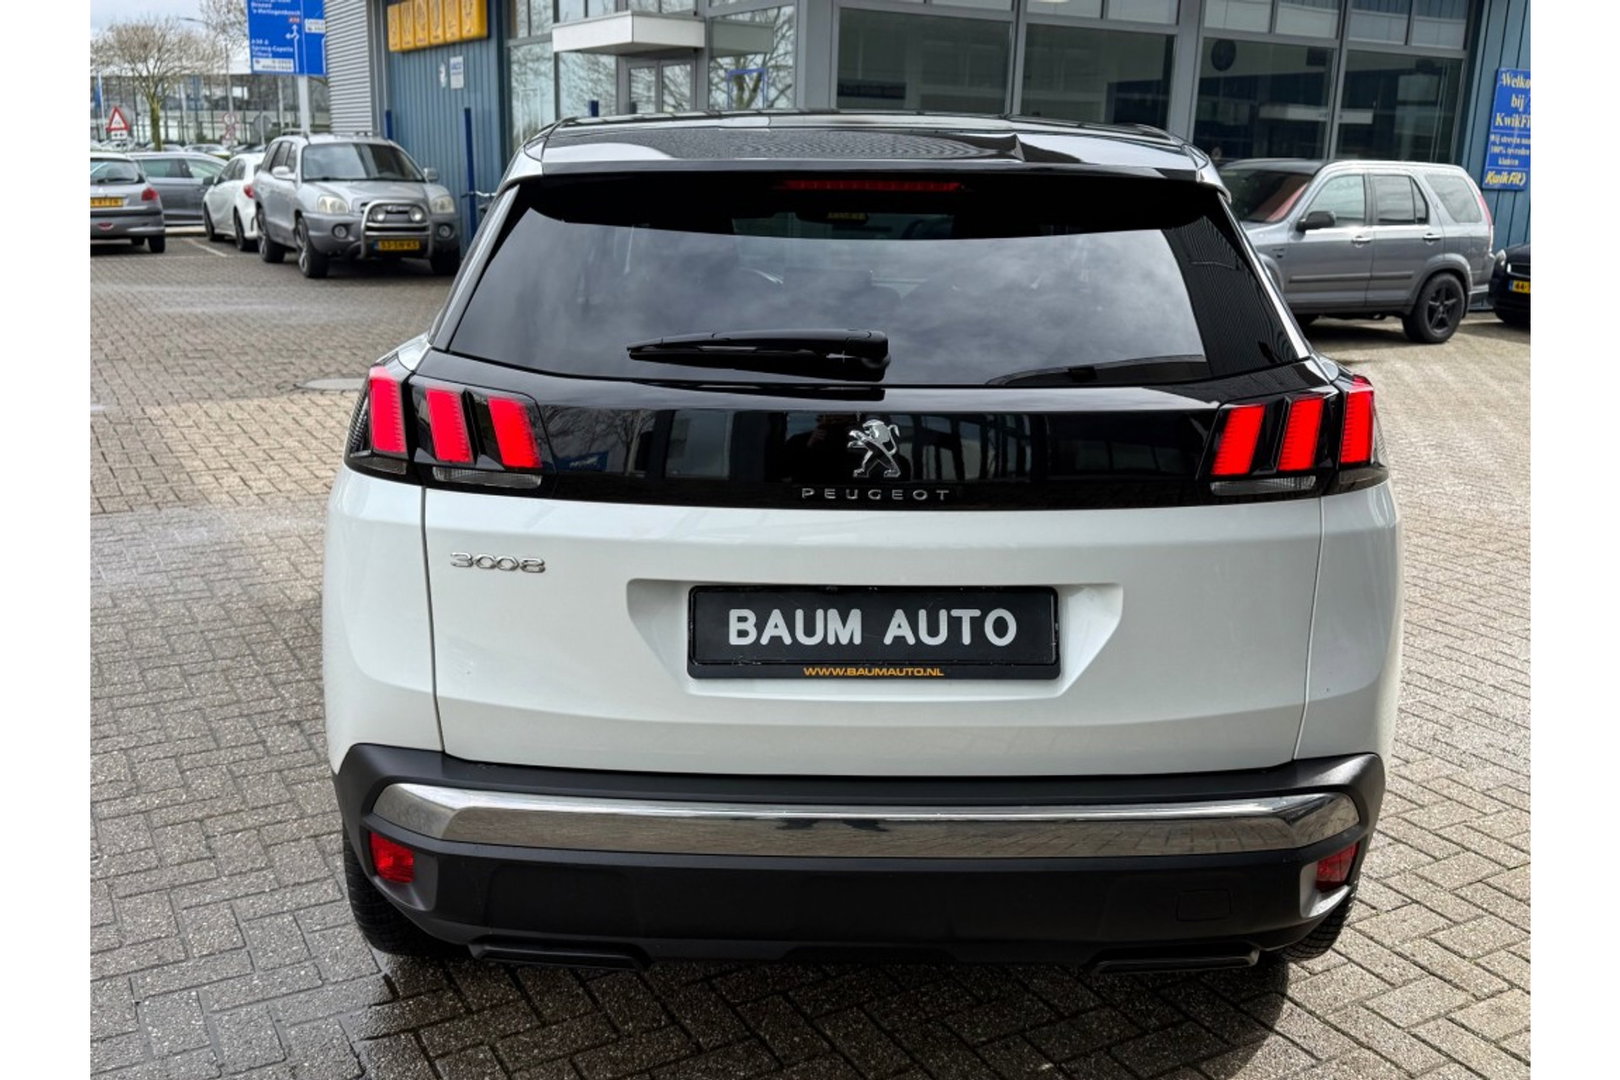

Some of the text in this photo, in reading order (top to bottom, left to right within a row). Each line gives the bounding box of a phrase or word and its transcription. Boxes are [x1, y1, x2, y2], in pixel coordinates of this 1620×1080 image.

[1511, 93, 1525, 112] bij
[802, 488, 949, 500] PEUGEOT
[450, 552, 546, 573] 3008
[728, 608, 1017, 646] BAUM AUTO
[803, 666, 945, 677] WWW.BAUMAUTO.NL
